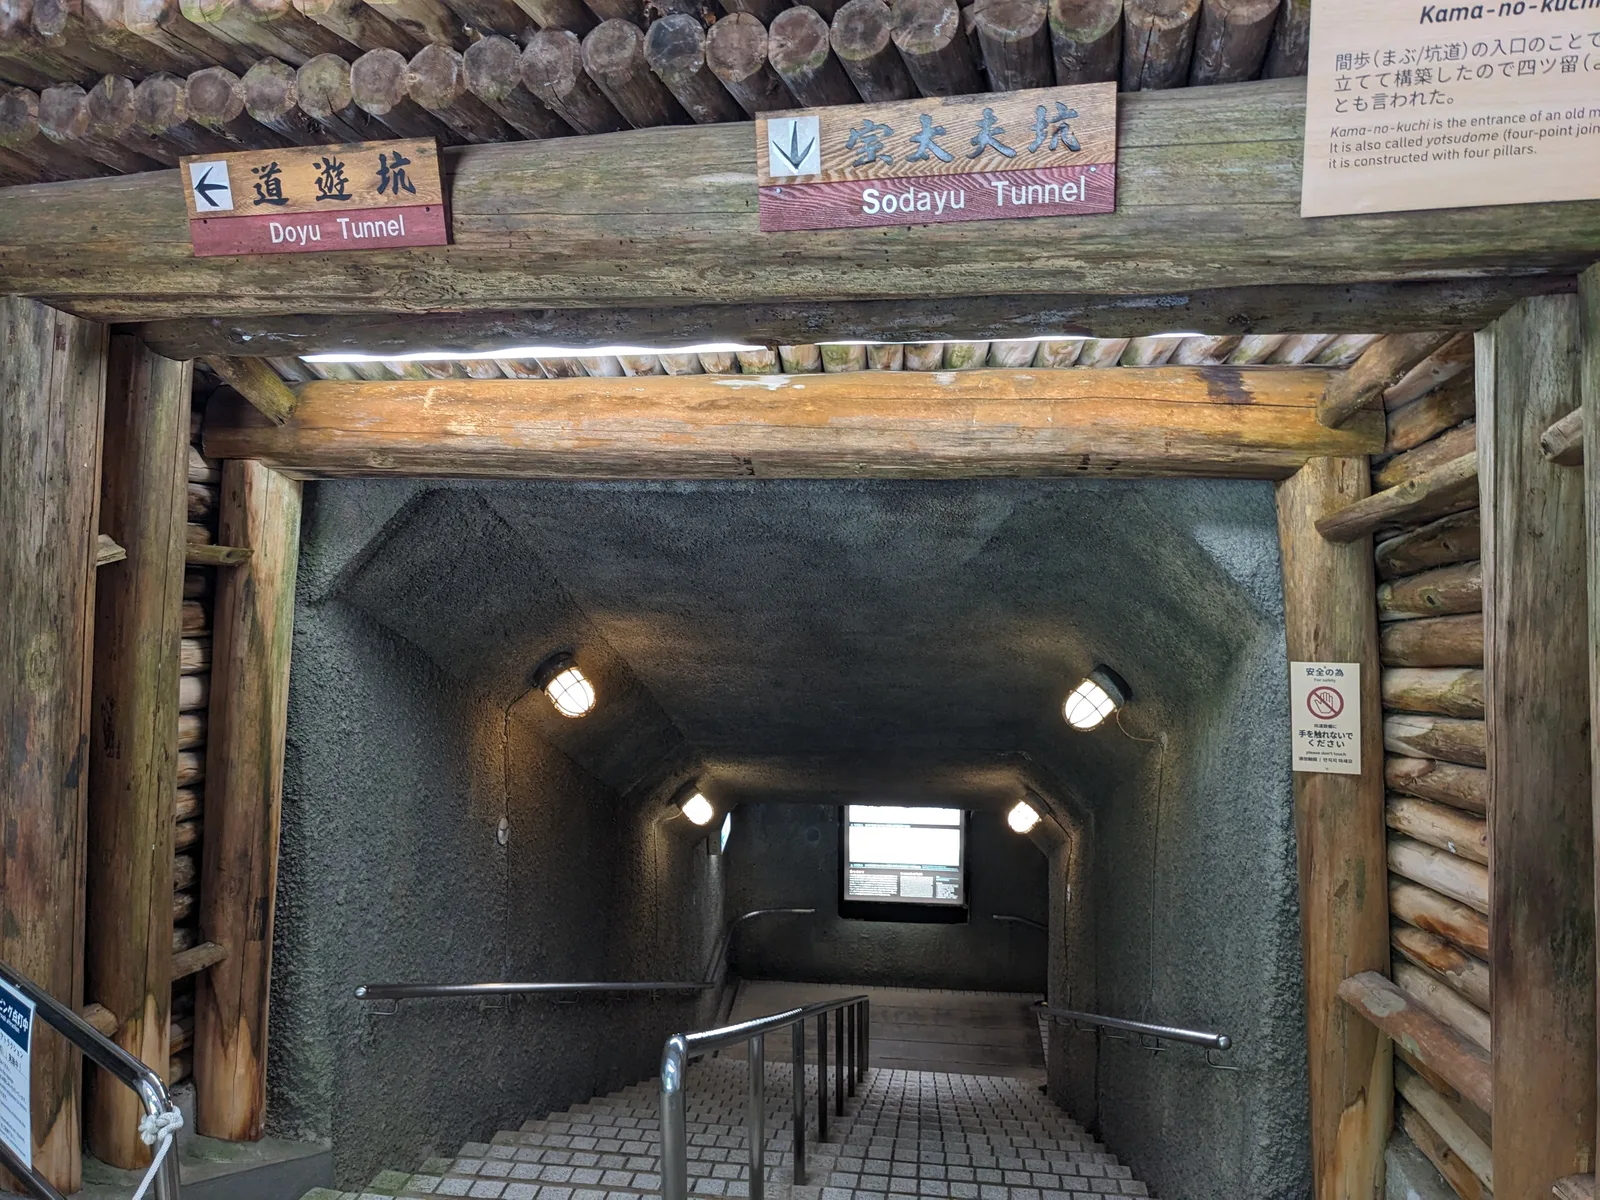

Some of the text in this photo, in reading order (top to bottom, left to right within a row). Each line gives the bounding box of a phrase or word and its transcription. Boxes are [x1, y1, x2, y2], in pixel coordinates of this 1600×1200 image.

[1335, 89, 1454, 113] とも言われた。
[1330, 119, 1430, 138] Kama-no-kuchi
[1433, 118, 1443, 129] is
[1447, 117, 1467, 129] the
[1470, 113, 1526, 127] entrance
[1529, 110, 1542, 122] of
[1545, 111, 1561, 121] an
[1565, 106, 1585, 119] old
[1329, 142, 1338, 153] It
[1341, 141, 1352, 152] is
[1355, 140, 1382, 151] also
[1385, 136, 1423, 149] called
[1426, 131, 1499, 148] yotsudome
[1502, 124, 1572, 142] (four-point
[1328, 144, 1537, 169] it is constructed with four pillars.
[250, 150, 417, 207] 道遊坑
[862, 175, 1086, 215] Sodayu Tunnel
[269, 213, 405, 246] Doyu Tunnel
[1306, 667, 1344, 677] 安全の為
[1298, 729, 1354, 740] 手を触れないで
[1308, 739, 1345, 748] ください
